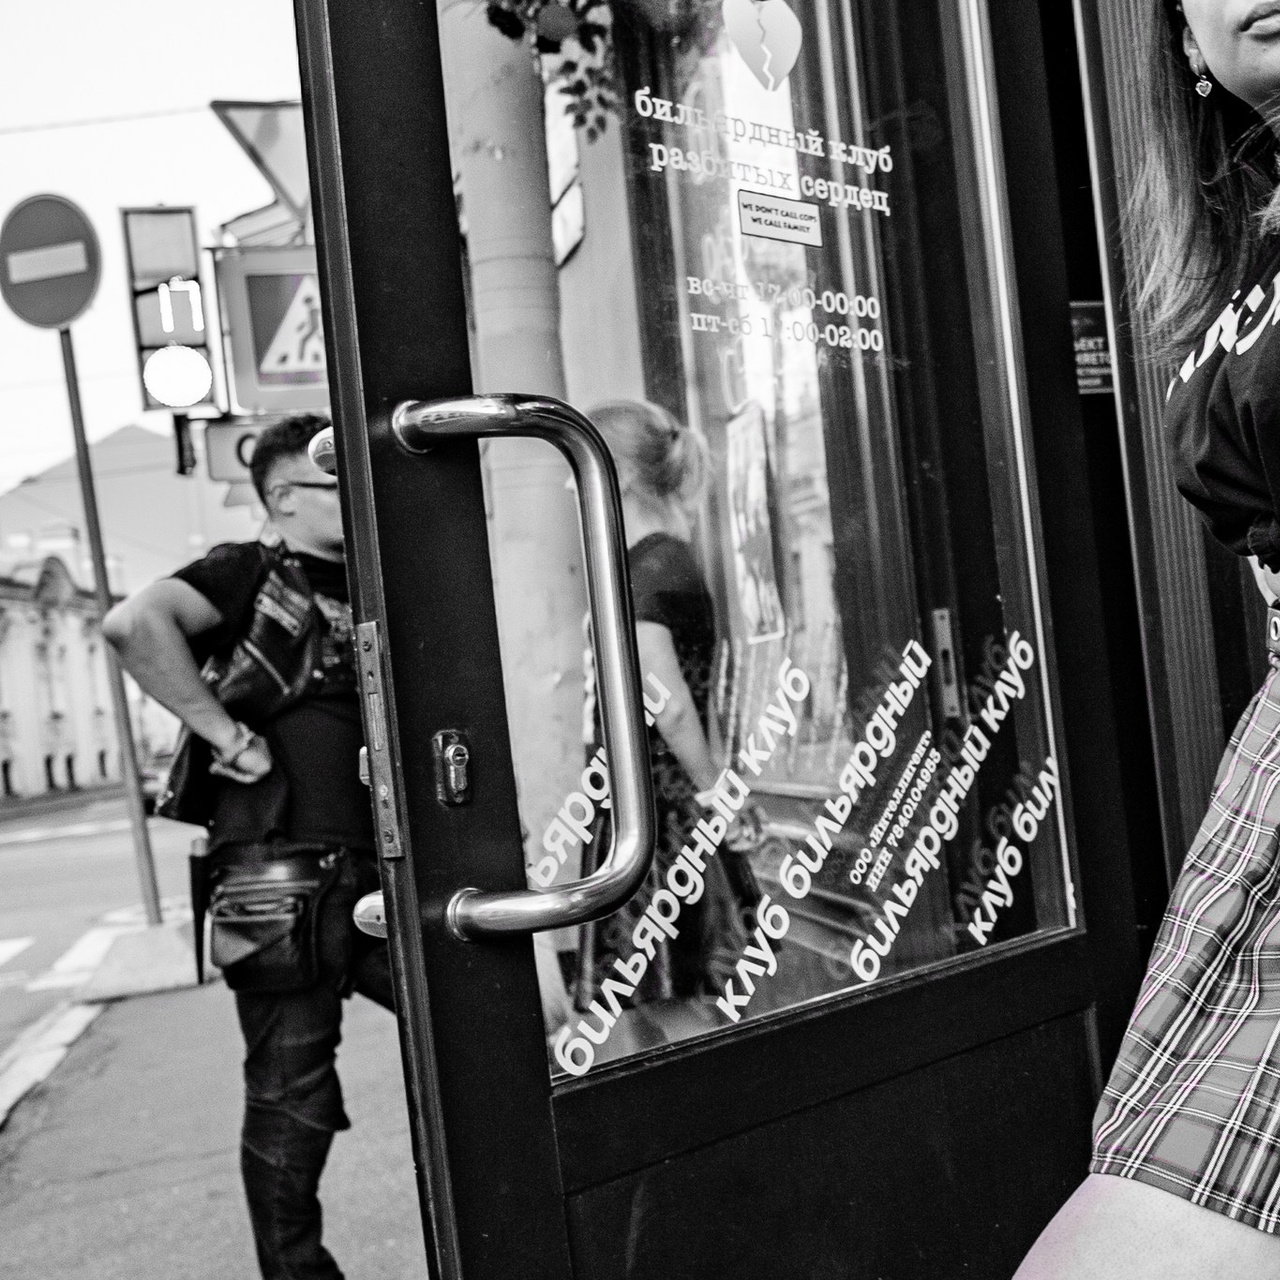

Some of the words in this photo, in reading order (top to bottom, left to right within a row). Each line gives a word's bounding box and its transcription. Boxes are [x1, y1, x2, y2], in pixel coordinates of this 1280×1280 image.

[829, 139, 893, 174] клуб
[649, 142, 793, 191] разбитых
[801, 175, 890, 217] сердец
[764, 219, 782, 228] CALL
[784, 222, 810, 233] FAMILY
[781, 210, 798, 220] CALL
[687, 276, 748, 300] вс-чт
[690, 313, 751, 336] пт-сб
[761, 317, 884, 352] 1:00-02:00
[851, 724, 991, 982] бильярдный
[980, 631, 1034, 734] клуб
[716, 895, 791, 1022] клуб
[779, 640, 932, 899] бильярдный
[554, 768, 751, 1076] бильярдный
[738, 657, 811, 776] клуб
[850, 848, 873, 885] ООО
[866, 846, 893, 892] ИНН
[967, 836, 1023, 946] клуб
